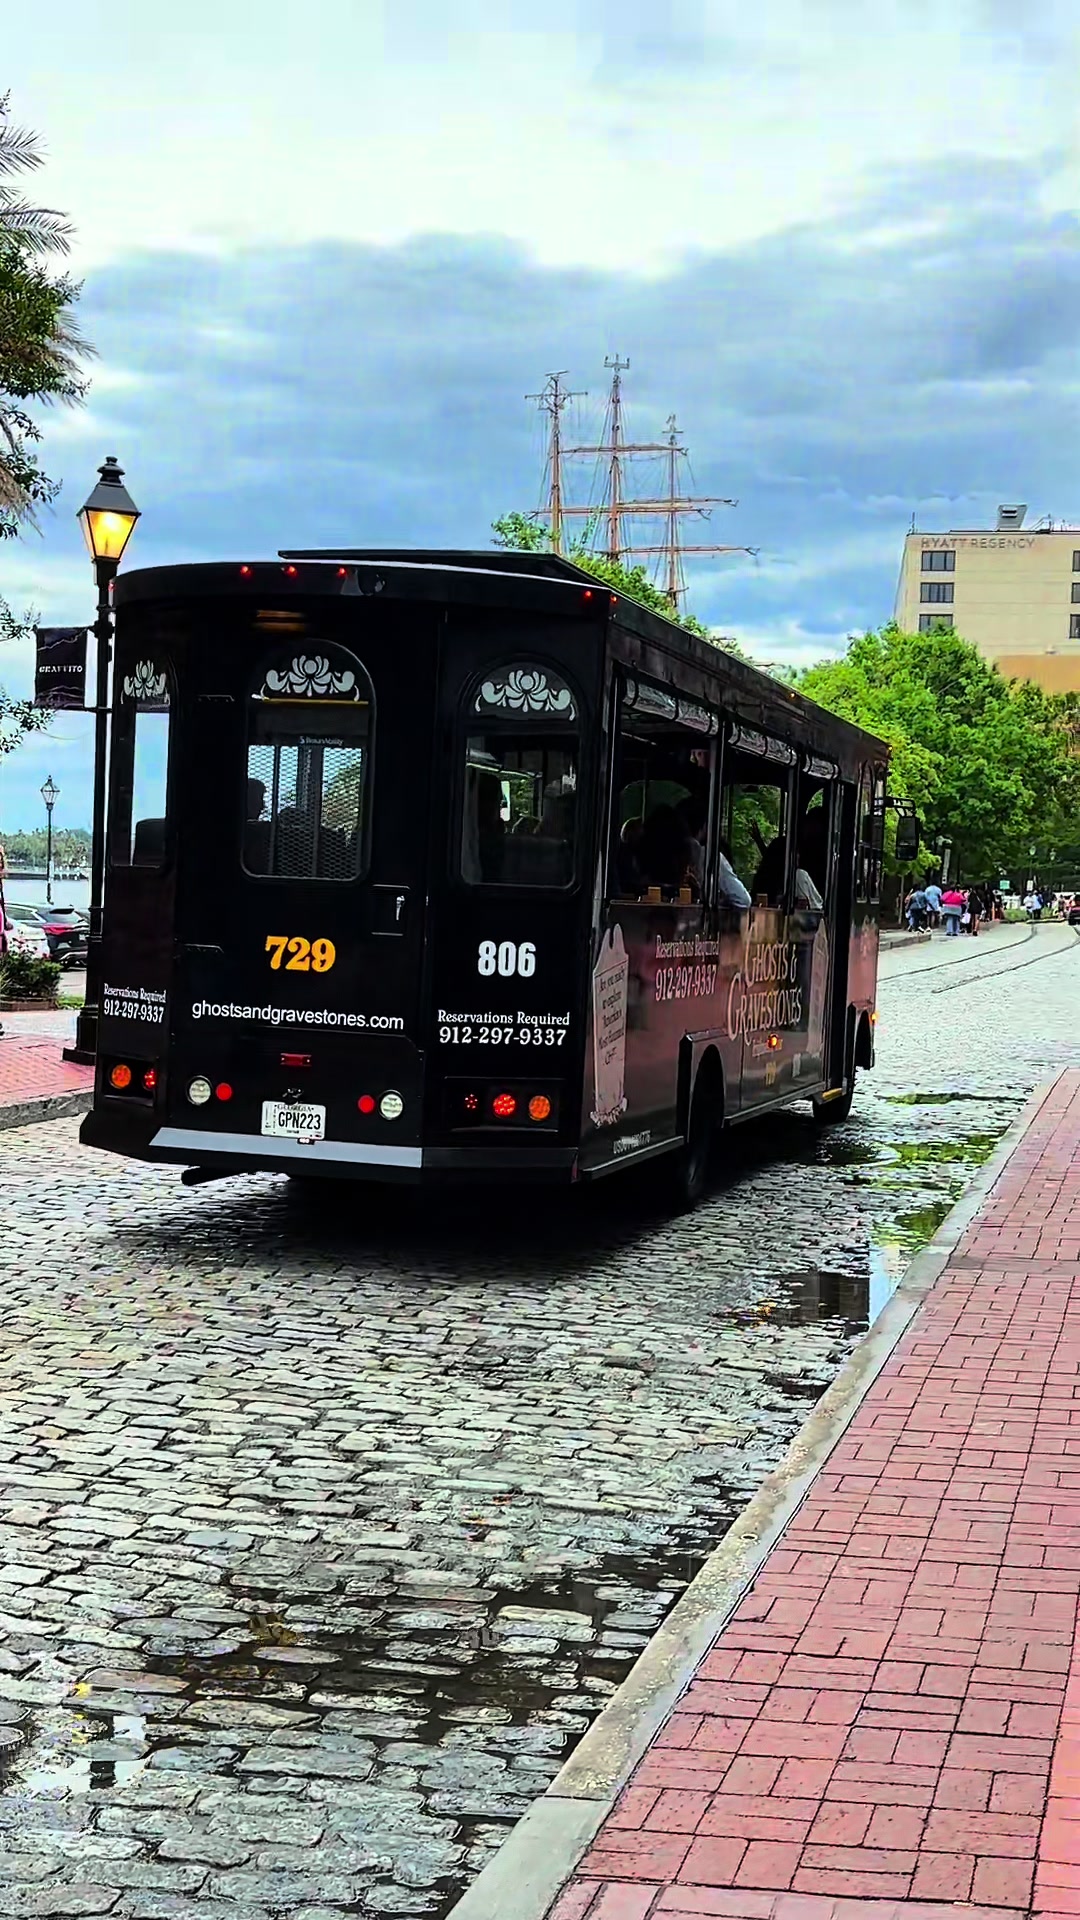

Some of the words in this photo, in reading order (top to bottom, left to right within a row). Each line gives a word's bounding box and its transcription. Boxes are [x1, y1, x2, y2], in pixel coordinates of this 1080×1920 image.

[921, 537, 967, 548] HYATT
[970, 537, 1036, 549] REGENCY
[265, 935, 336, 973] 729
[477, 940, 537, 977] 806
[655, 934, 694, 959] Reservations
[694, 931, 720, 962] Required
[744, 921, 789, 988] GHOSTS
[103, 982, 139, 999] Reservations
[139, 987, 167, 1004] Required
[655, 964, 717, 1002] 912-297-9337
[103, 998, 165, 1023] 912-297-9337
[191, 1000, 404, 1030] ghostsandgravestones.com
[437, 1009, 514, 1024] Reservations
[516, 1011, 570, 1028] Required
[727, 972, 803, 1047] GRAVESTONES
[439, 1026, 567, 1046] 912-297-9337
[278, 1111, 321, 1130] GPN223
